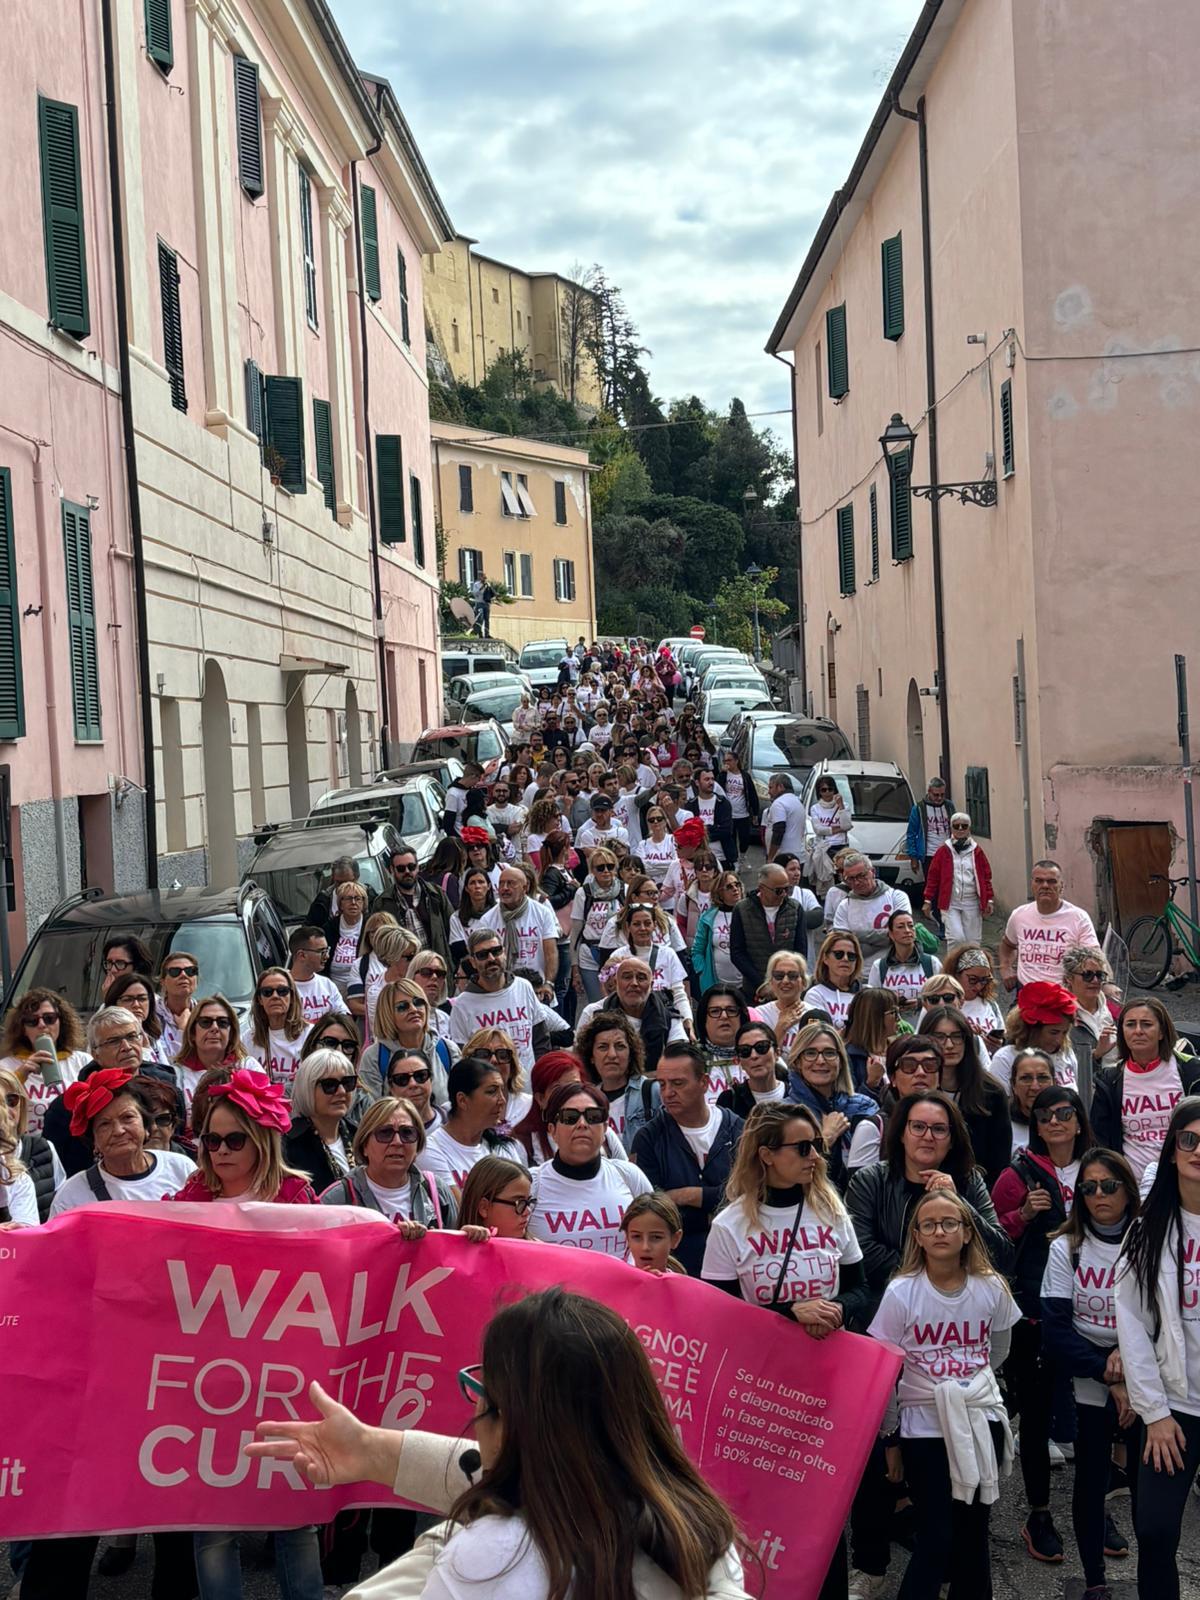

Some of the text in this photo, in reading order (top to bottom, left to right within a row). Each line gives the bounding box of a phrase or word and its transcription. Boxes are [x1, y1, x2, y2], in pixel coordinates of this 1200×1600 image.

[1023, 929, 1066, 943] WALK
[884, 974, 926, 987] WALK
[301, 995, 332, 1010] ALK
[476, 1006, 528, 1028] WALK
[1121, 1092, 1183, 1116] WALK
[545, 1205, 626, 1234] WAL
[747, 1224, 837, 1256] WALK
[752, 1259, 799, 1282] FOR
[166, 1259, 455, 1347] WALK
[755, 1279, 822, 1303] CURE
[633, 1323, 708, 1364] GNOSI
[146, 1353, 305, 1420] FOR
[735, 1368, 828, 1410] Se un tumore
[721, 1404, 825, 1449] in fase precoce
[728, 1386, 834, 1432] è diagnosticato
[138, 1424, 334, 1491] CUR
[717, 1424, 837, 1477] si guarisce in oltre
[722, 1446, 750, 1466] 90%
[752, 1454, 776, 1474] dei
[777, 1463, 807, 1484] casi
